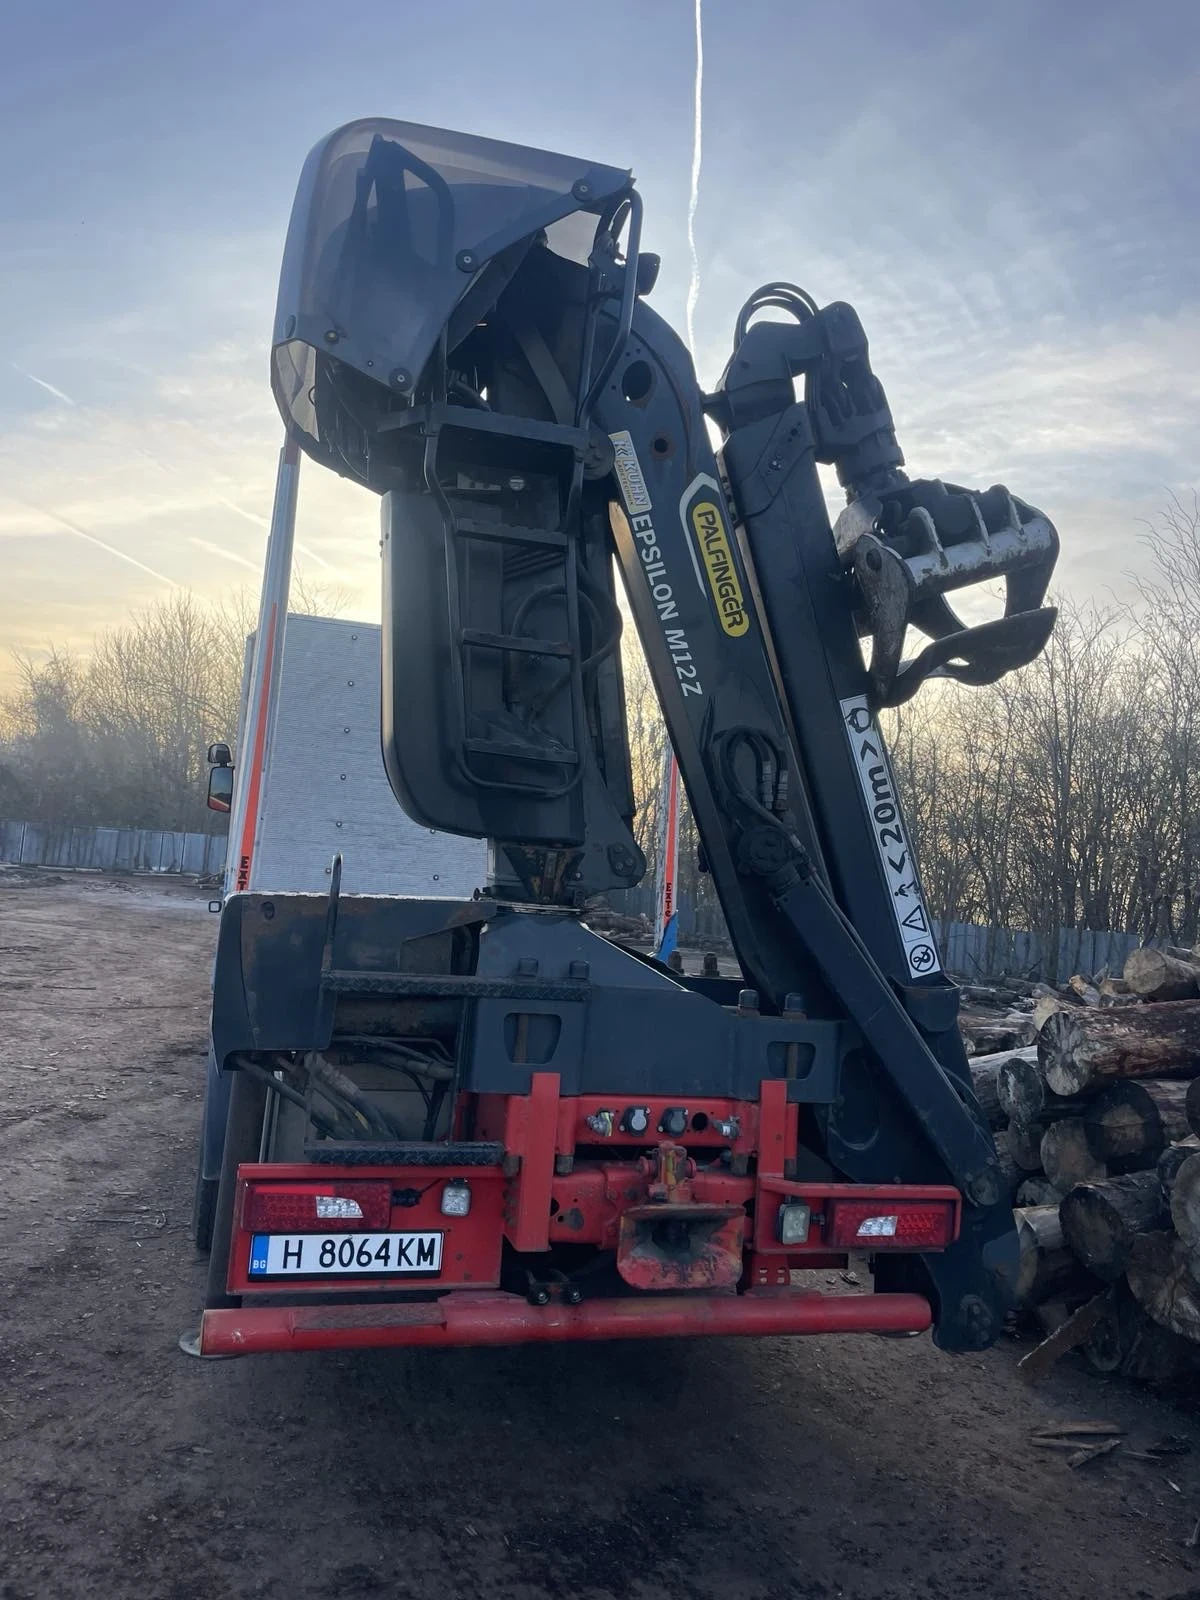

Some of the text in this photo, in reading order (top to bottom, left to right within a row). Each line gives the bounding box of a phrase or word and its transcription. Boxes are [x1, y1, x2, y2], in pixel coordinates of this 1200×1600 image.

[623, 459, 648, 506] KUHN
[697, 510, 745, 629] PALFINGER
[632, 514, 703, 697] EPSILON M12Z
[252, 1259, 267, 1270] BG
[282, 1239, 304, 1269] H
